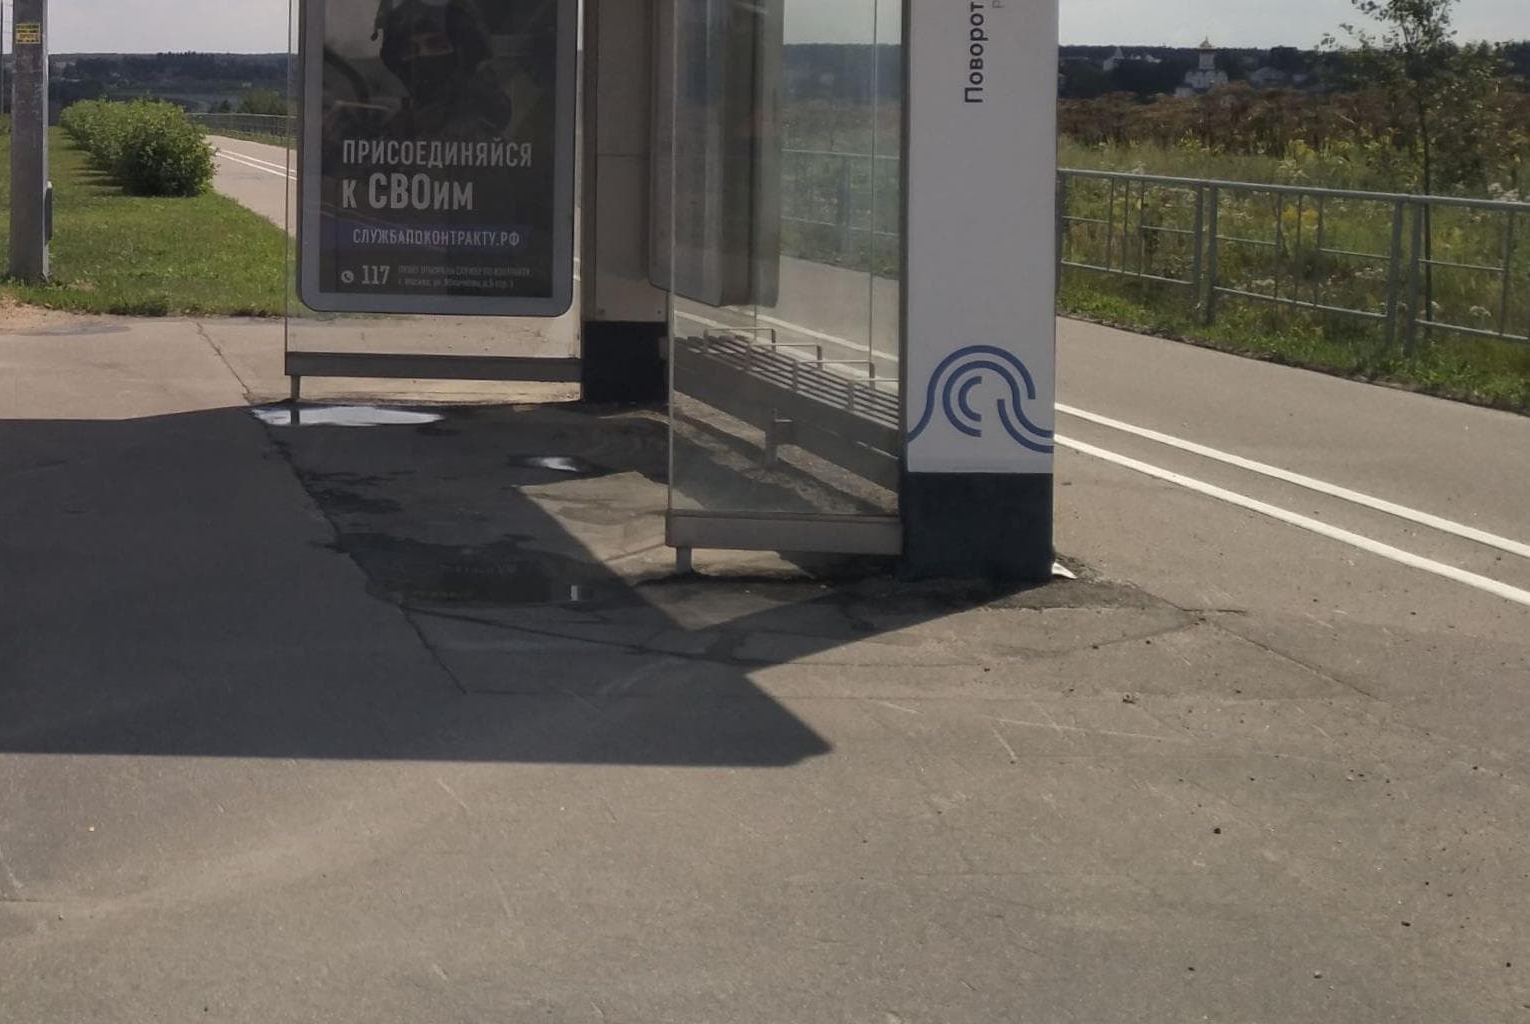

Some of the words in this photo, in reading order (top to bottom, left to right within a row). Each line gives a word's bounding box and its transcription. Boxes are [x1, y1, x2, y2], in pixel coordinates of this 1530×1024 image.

[964, 1, 988, 103] Поворот
[342, 137, 532, 168] ПРИСОЕДИНЯЙСЯ
[352, 228, 520, 247] СЛУЖБАПОКОНТРАКТУ.РФ
[361, 264, 391, 286] 117
